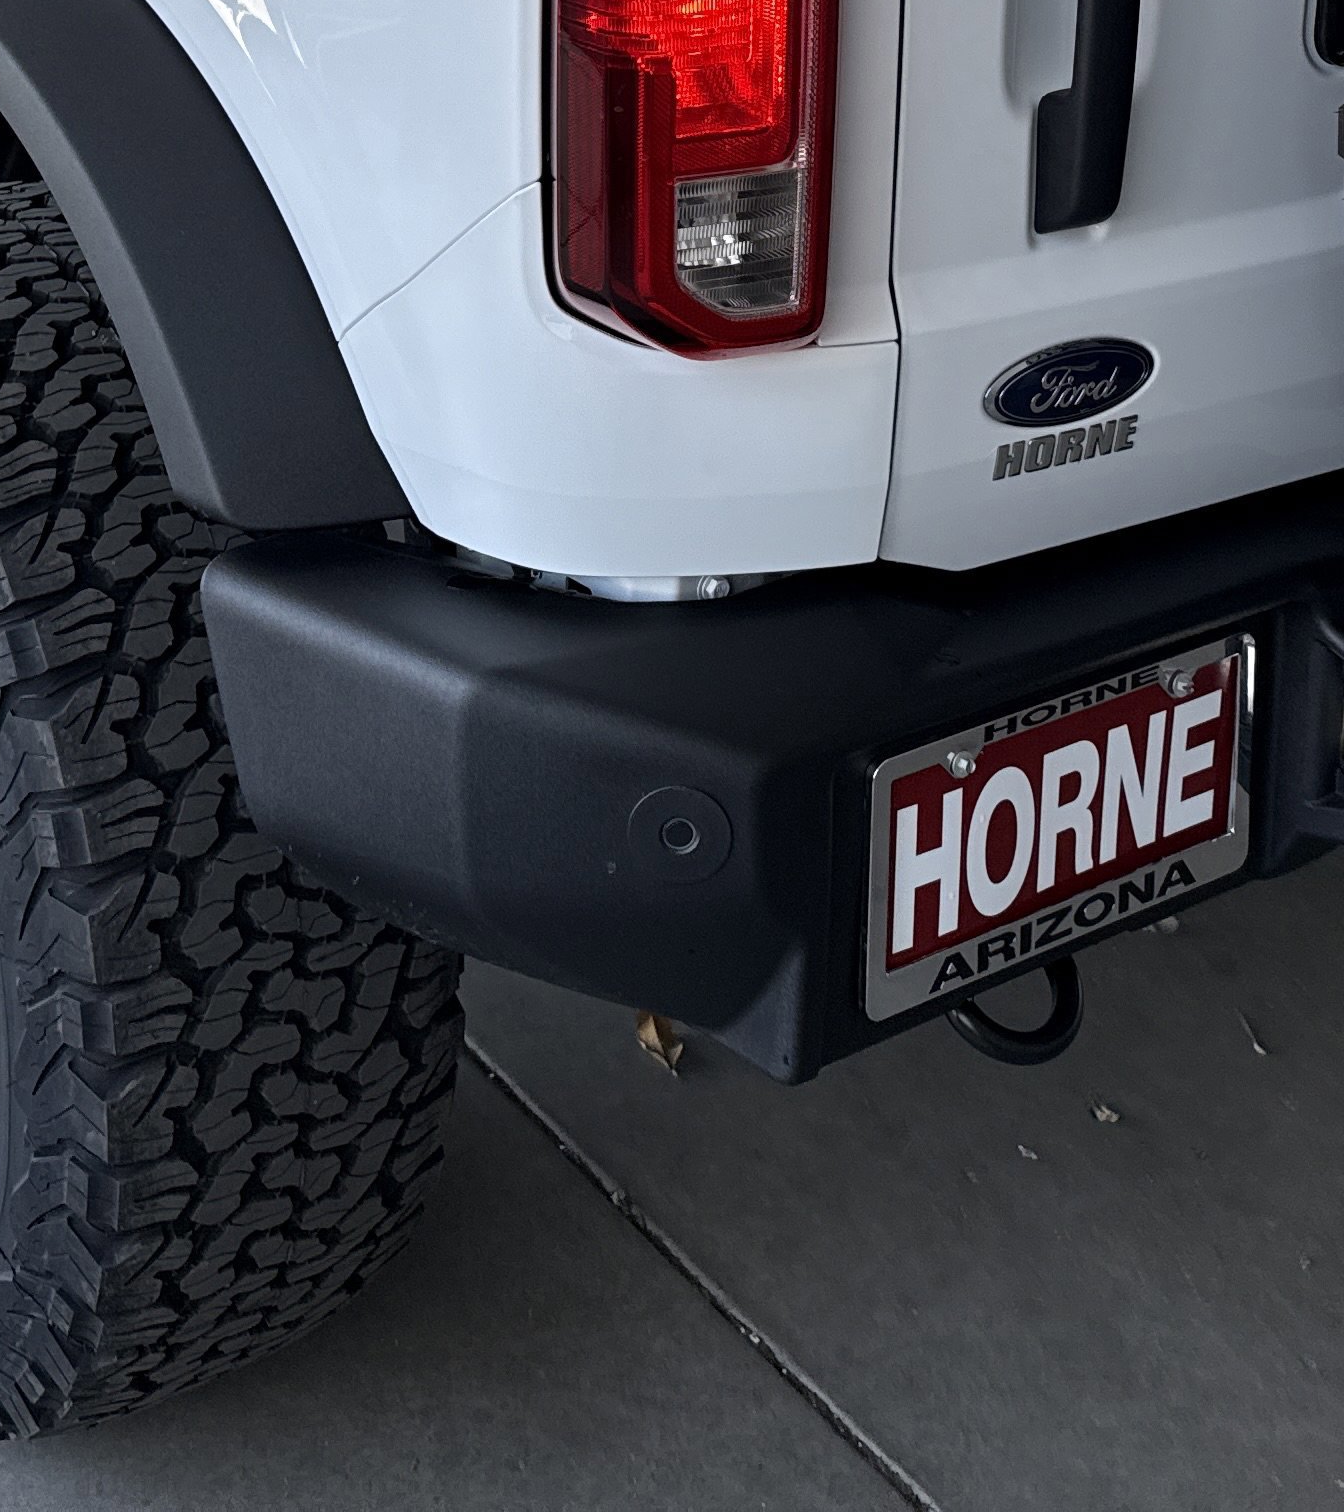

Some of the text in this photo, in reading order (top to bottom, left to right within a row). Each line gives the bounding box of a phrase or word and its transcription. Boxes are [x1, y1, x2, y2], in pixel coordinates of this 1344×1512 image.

[1029, 360, 1119, 414] Ford
[992, 414, 1139, 481] HORNE
[983, 662, 1162, 744] HORNE
[891, 688, 1223, 955] HORNE
[928, 859, 1197, 996] ARIZONA
